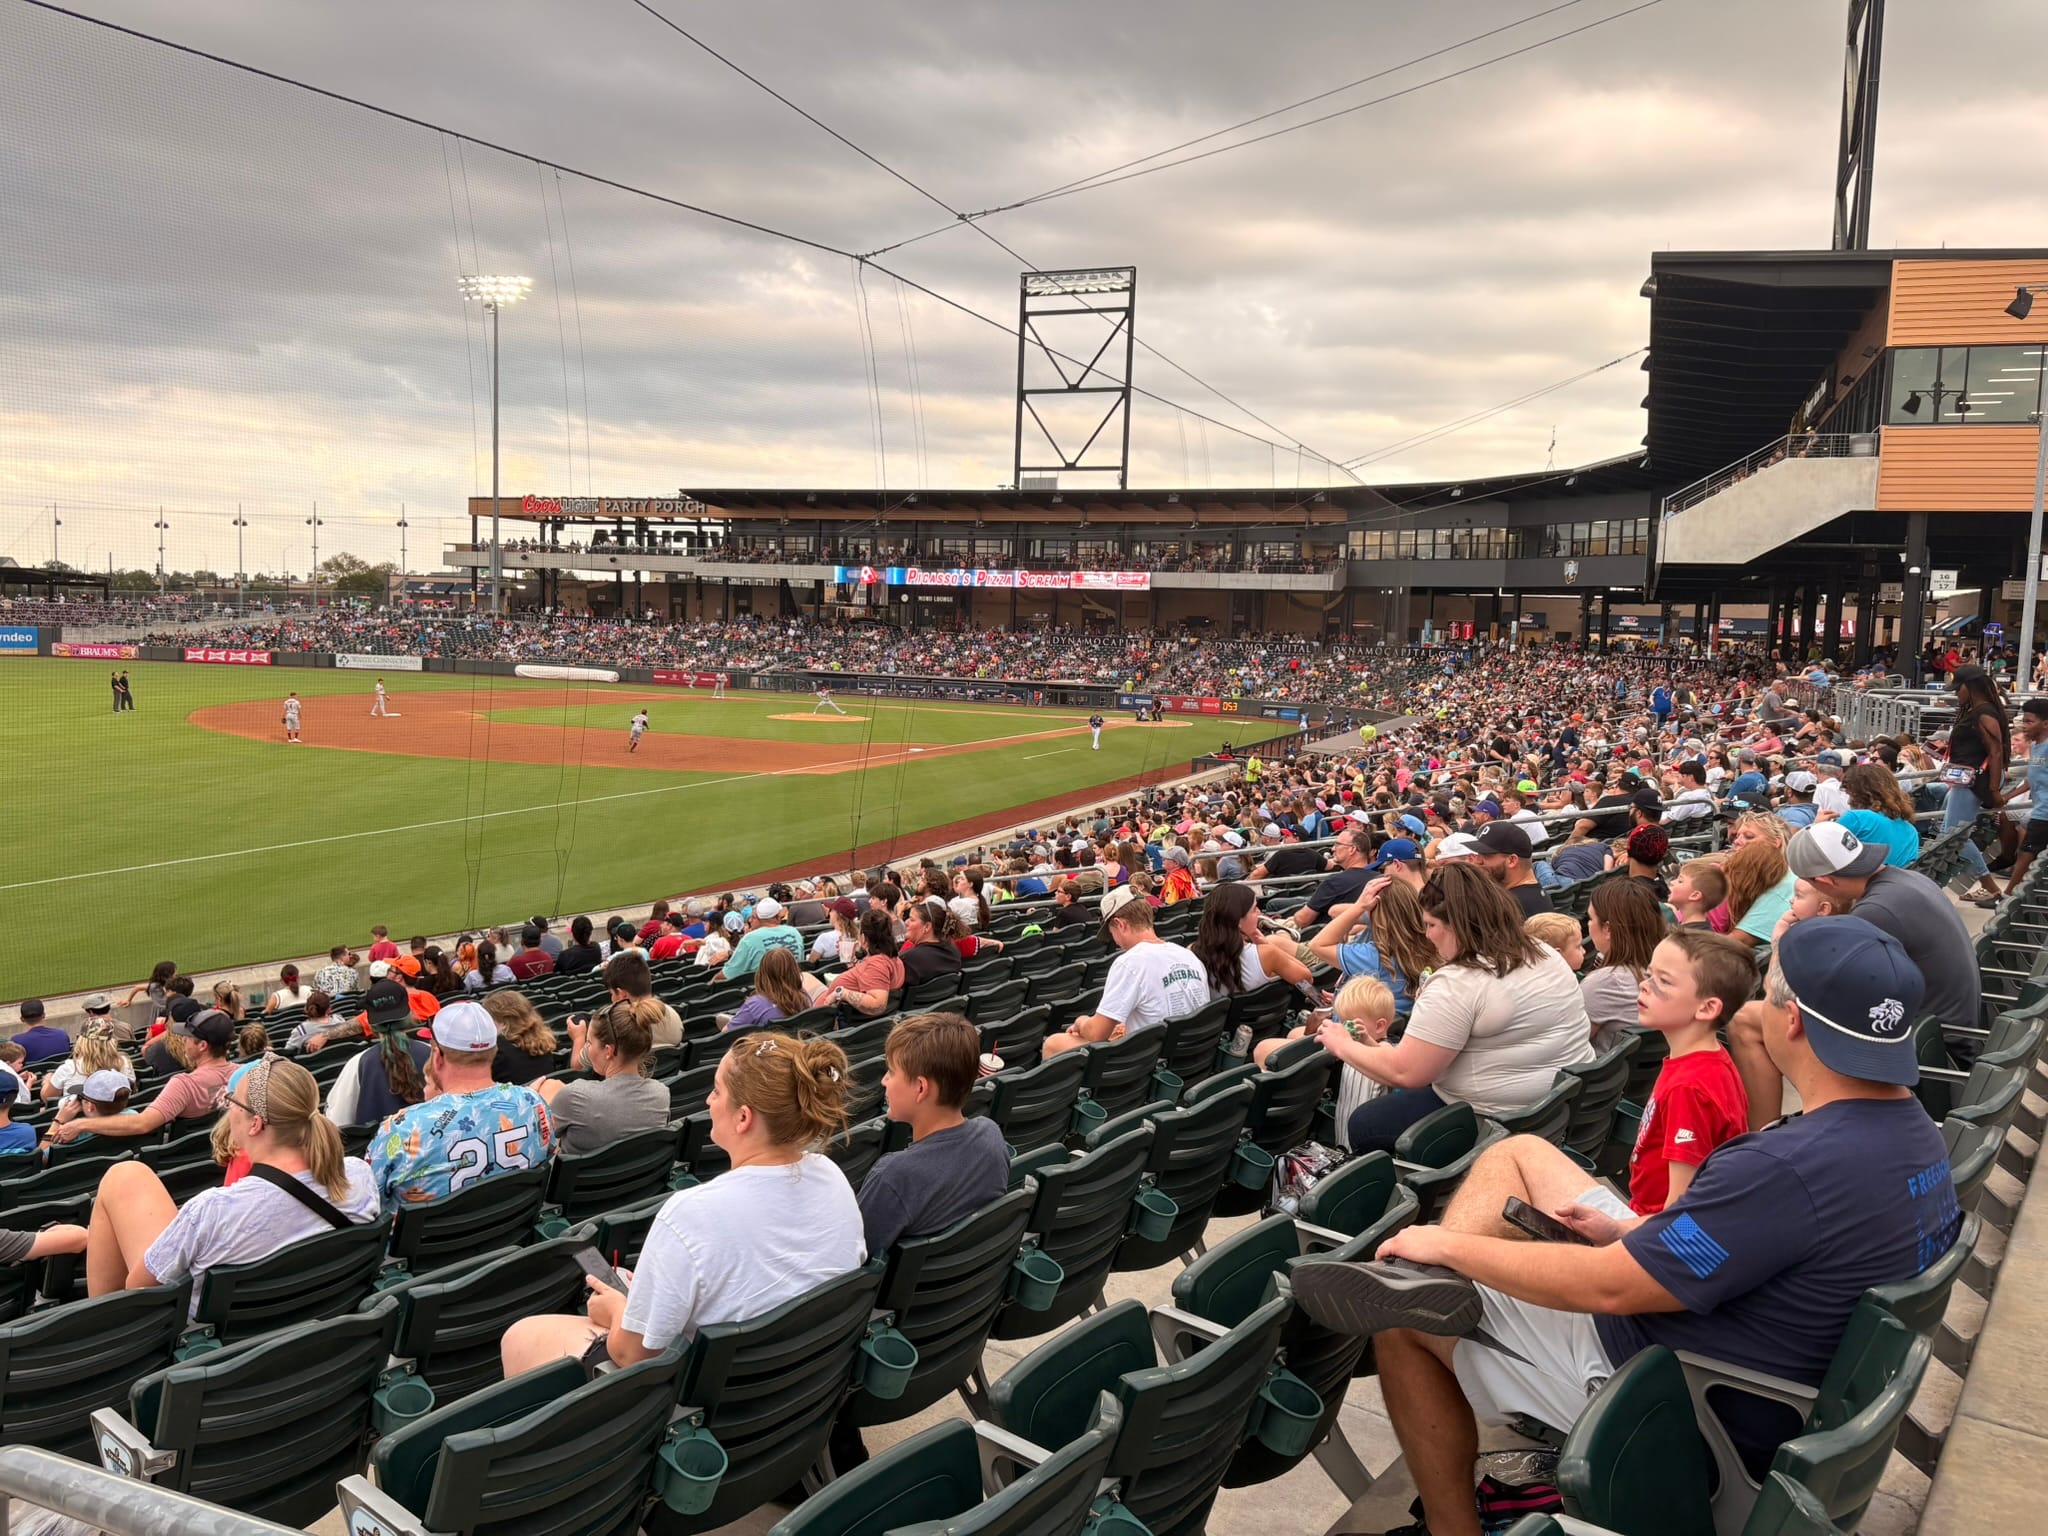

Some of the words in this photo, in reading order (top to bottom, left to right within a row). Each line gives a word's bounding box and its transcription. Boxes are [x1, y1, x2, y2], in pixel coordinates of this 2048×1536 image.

[605, 500, 649, 513] PARTY
[655, 500, 707, 513] PORCH
[1018, 570, 1070, 587] SCREAM
[80, 649, 118, 657] BRAUM'S
[1266, 643, 1312, 653] CAPITAL
[448, 1124, 530, 1193] 25
[1907, 1157, 1950, 1200] FREEDO
